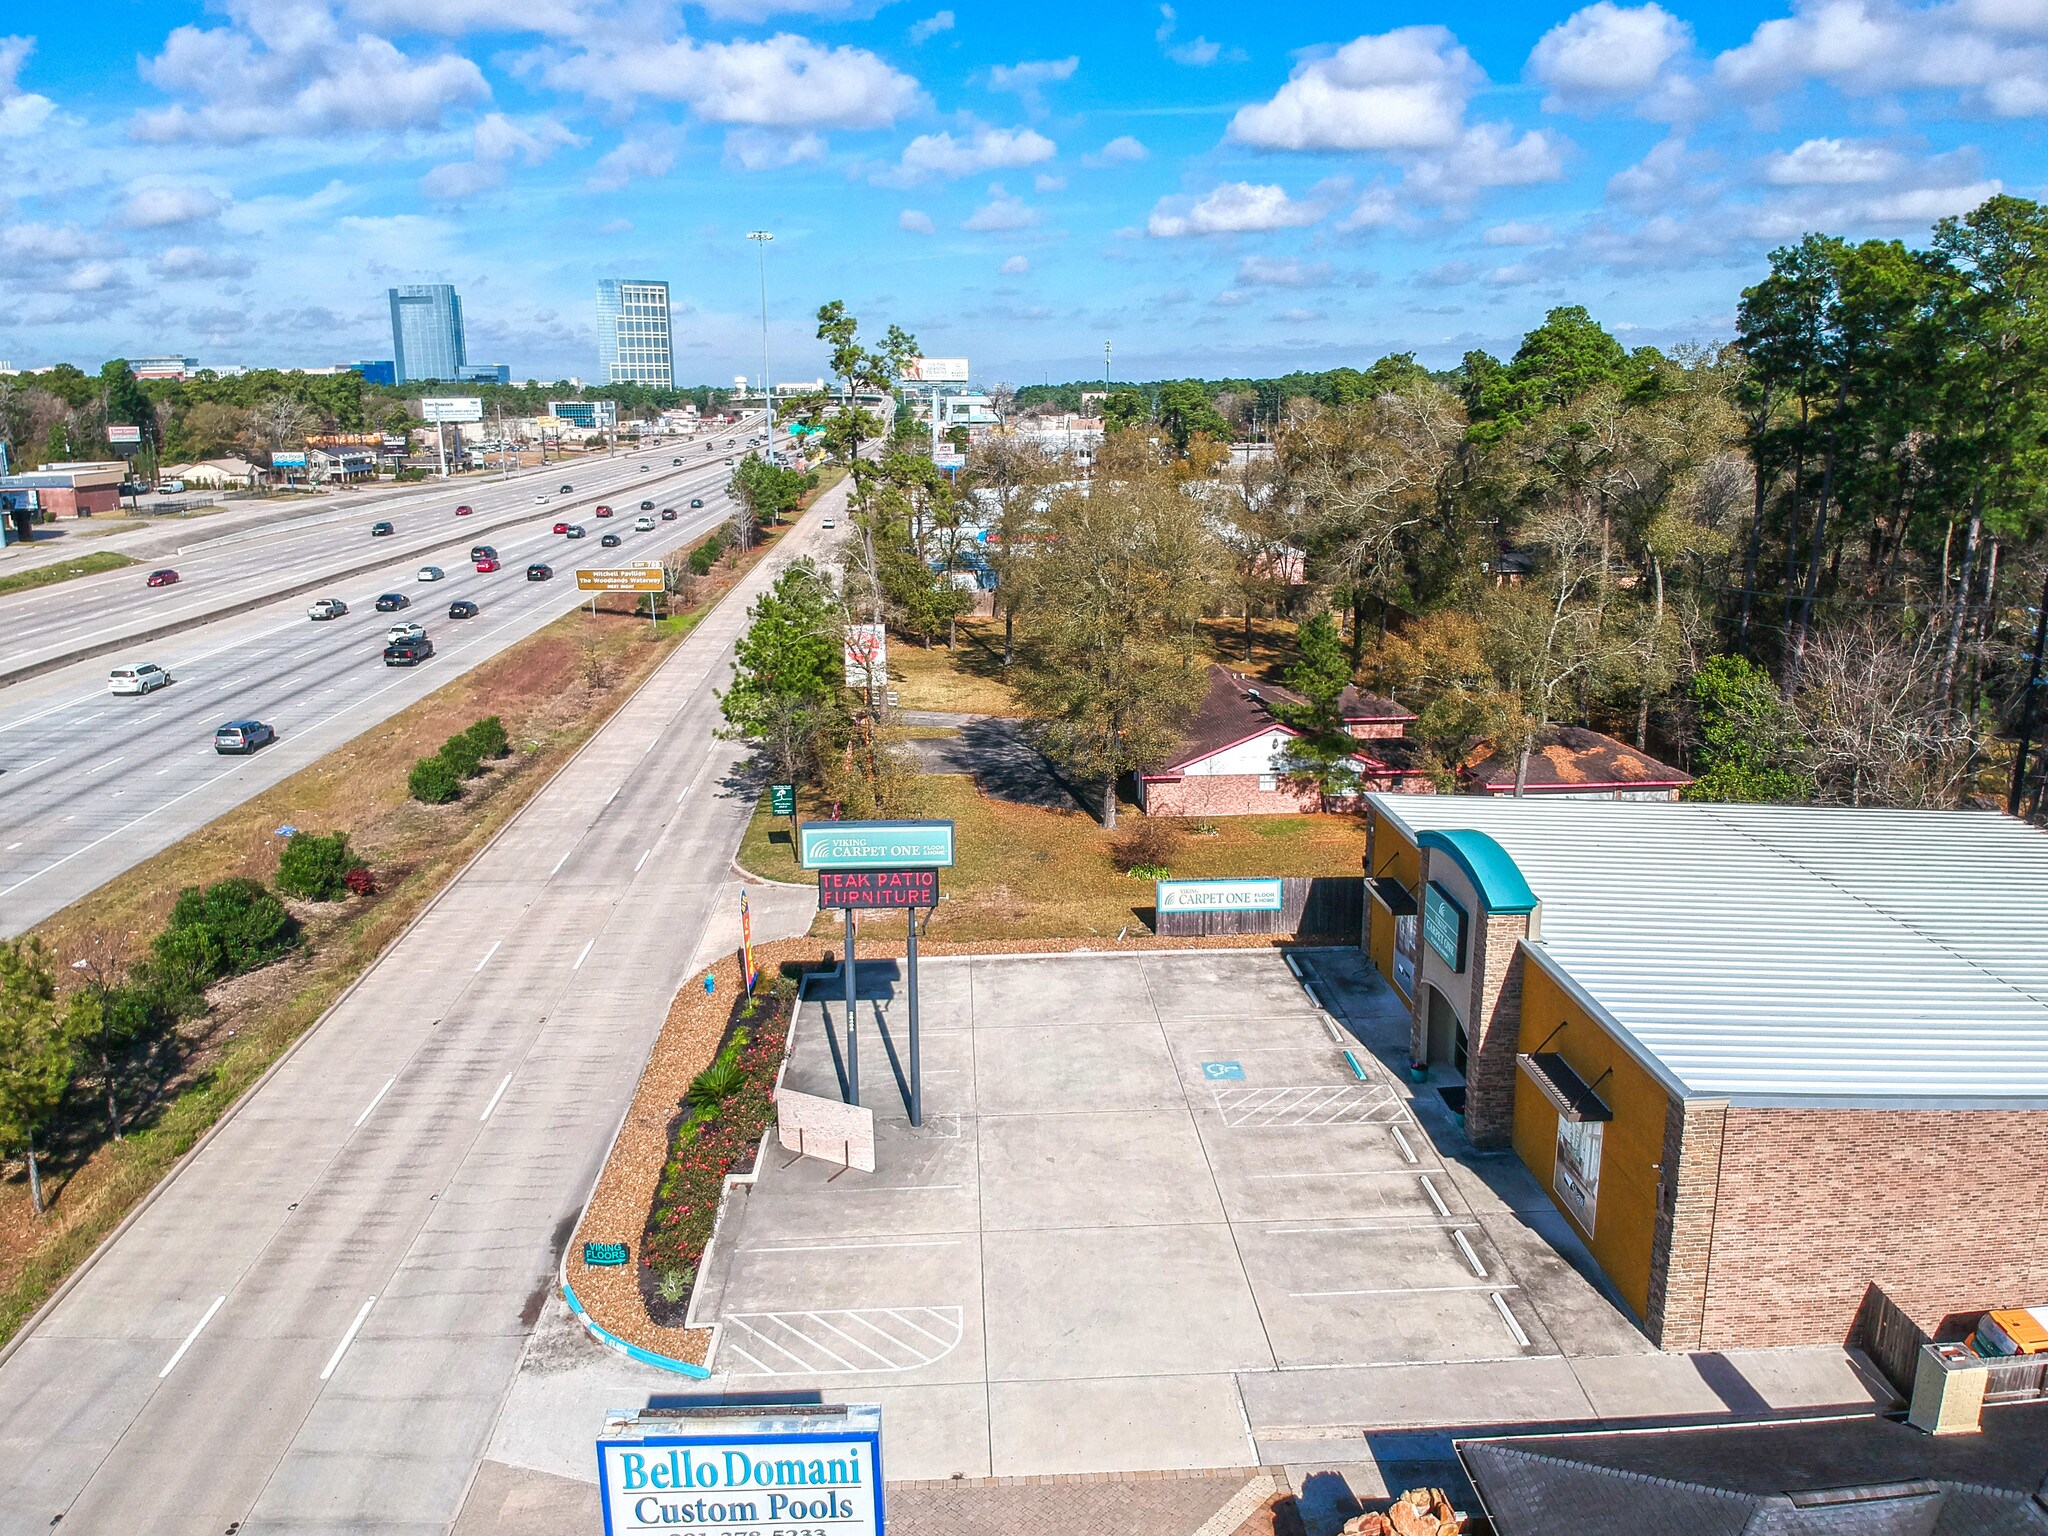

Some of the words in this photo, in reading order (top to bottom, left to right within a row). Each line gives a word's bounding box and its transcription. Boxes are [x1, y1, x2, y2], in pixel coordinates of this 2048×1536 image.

[630, 577, 662, 585] Waterway
[832, 838, 868, 846] VIKING
[832, 846, 887, 858] CARPET
[890, 845, 921, 857] ONE
[820, 873, 872, 889] TEAK
[877, 871, 934, 887] PATIO
[823, 888, 931, 906] FURNITURE
[1178, 892, 1225, 906] CARPET
[1225, 892, 1251, 904] ONE
[1426, 919, 1444, 944] CARPET
[1443, 938, 1455, 957] ONE
[589, 1242, 622, 1252] VIKING
[585, 1250, 626, 1260] FLOORS
[619, 1448, 719, 1490] Bello
[721, 1447, 862, 1488] Domani
[634, 1495, 760, 1525] Custom
[767, 1489, 854, 1521] Pools
